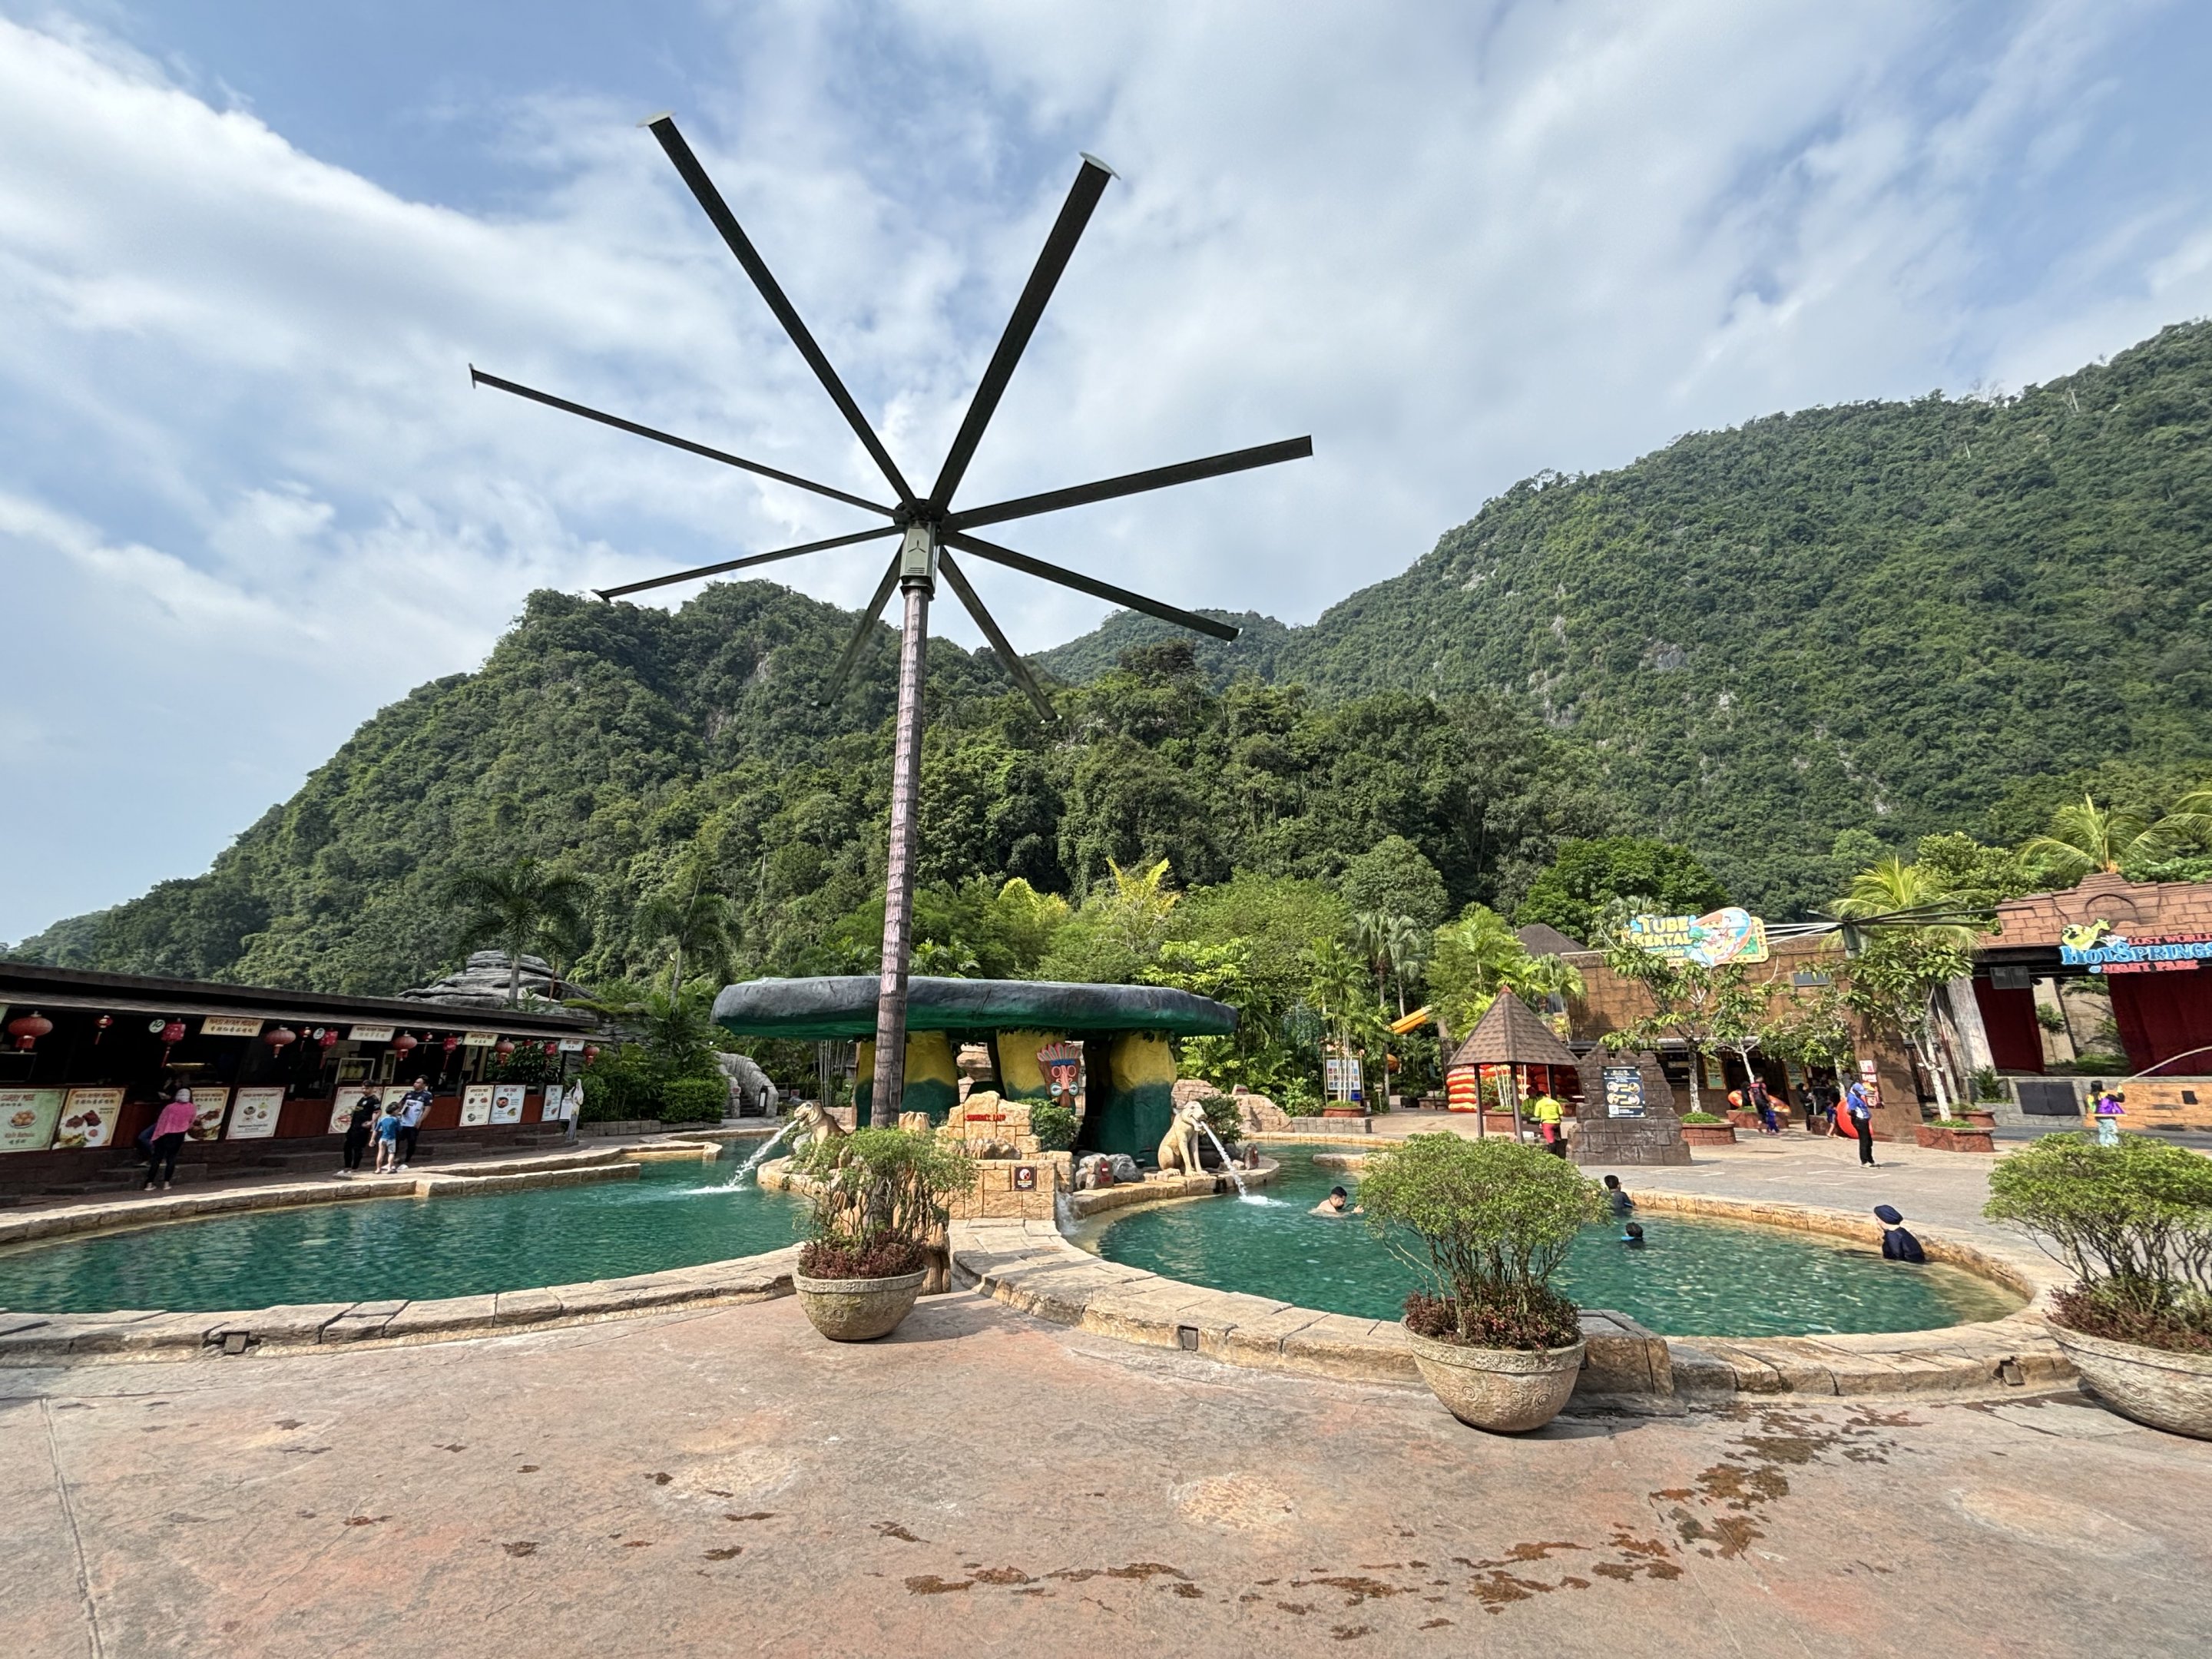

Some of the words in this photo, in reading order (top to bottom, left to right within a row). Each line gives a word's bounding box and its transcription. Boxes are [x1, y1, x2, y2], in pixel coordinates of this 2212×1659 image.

[1637, 916, 1690, 934] TUBE
[1631, 932, 1692, 947] RENTAL
[2128, 935, 2161, 945] LOST
[2165, 933, 2212, 942] WORLD
[2154, 960, 2199, 972] PARK
